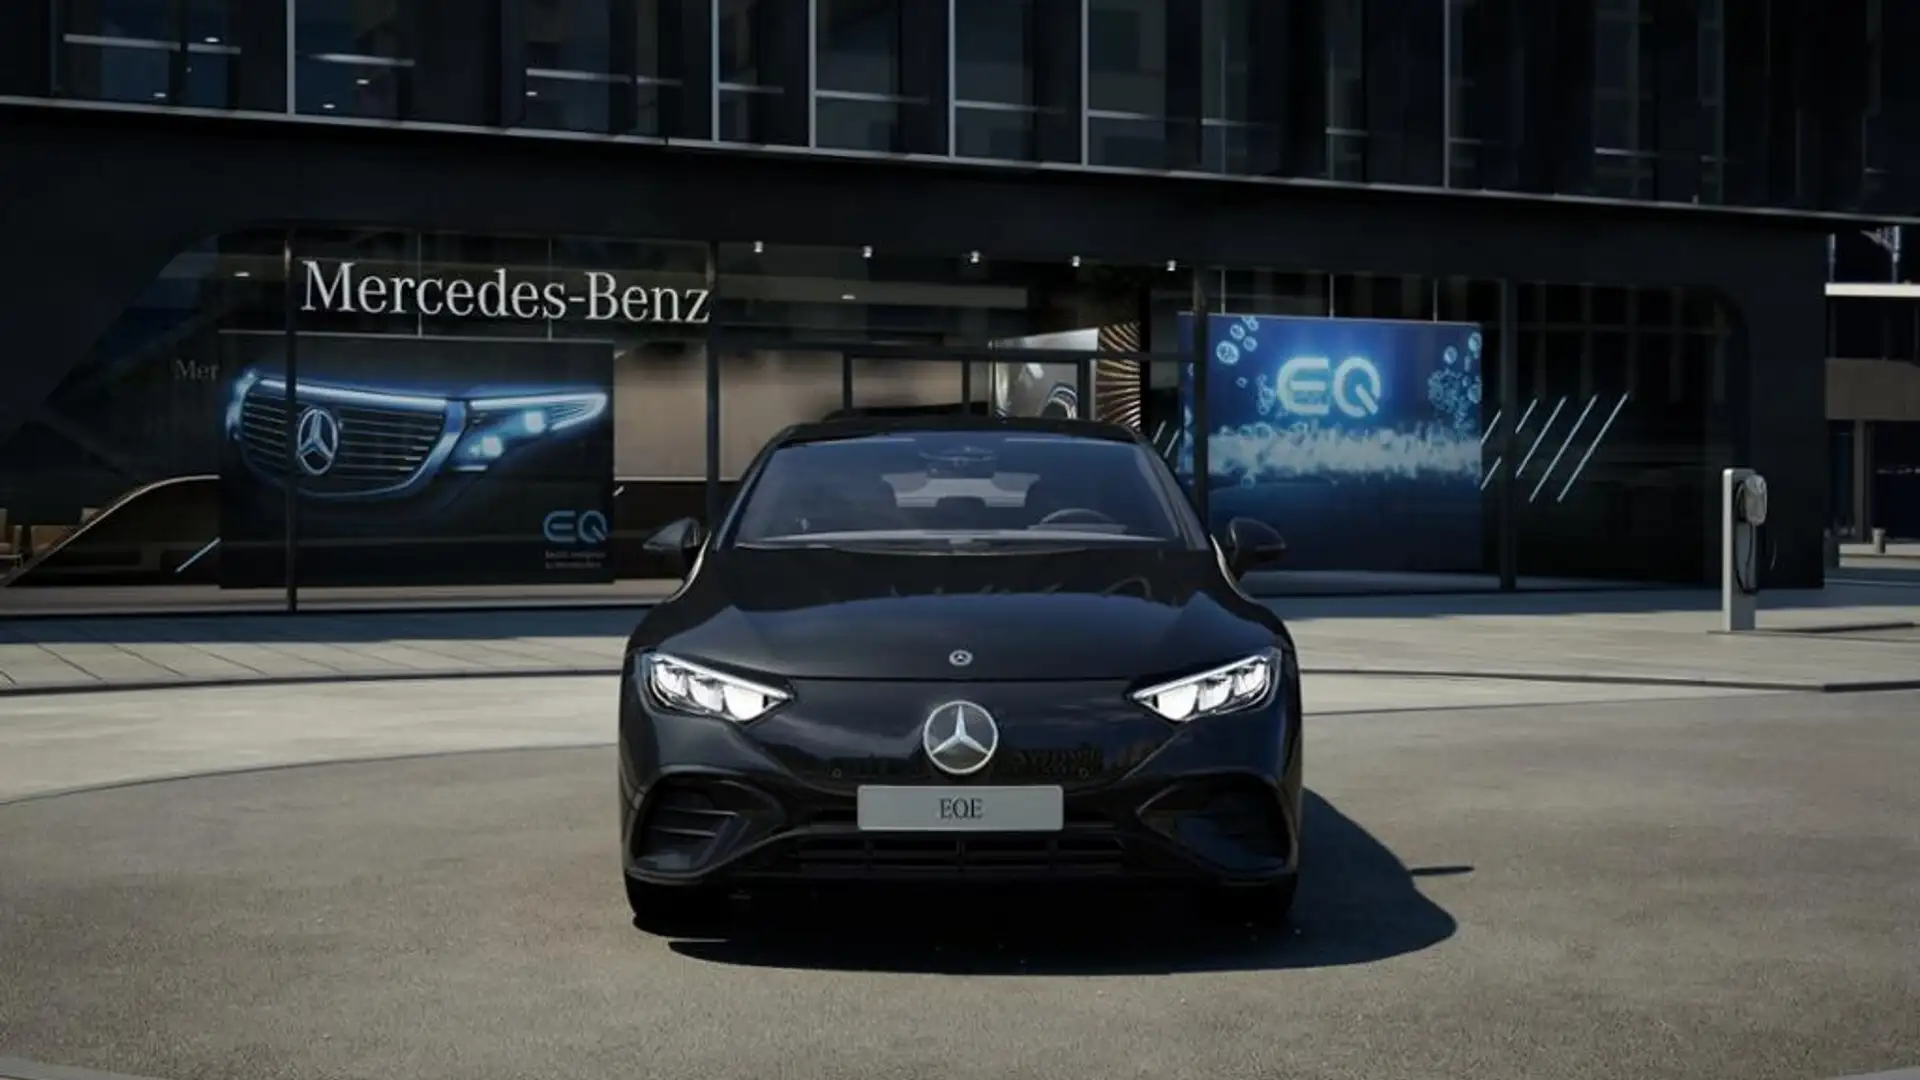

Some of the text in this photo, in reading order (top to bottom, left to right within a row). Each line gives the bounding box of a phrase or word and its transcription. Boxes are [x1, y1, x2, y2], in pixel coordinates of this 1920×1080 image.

[301, 260, 711, 324] Mercedes-Benz
[1276, 356, 1382, 418] EQ
[543, 510, 608, 542] EQ
[940, 798, 983, 819] EQE
